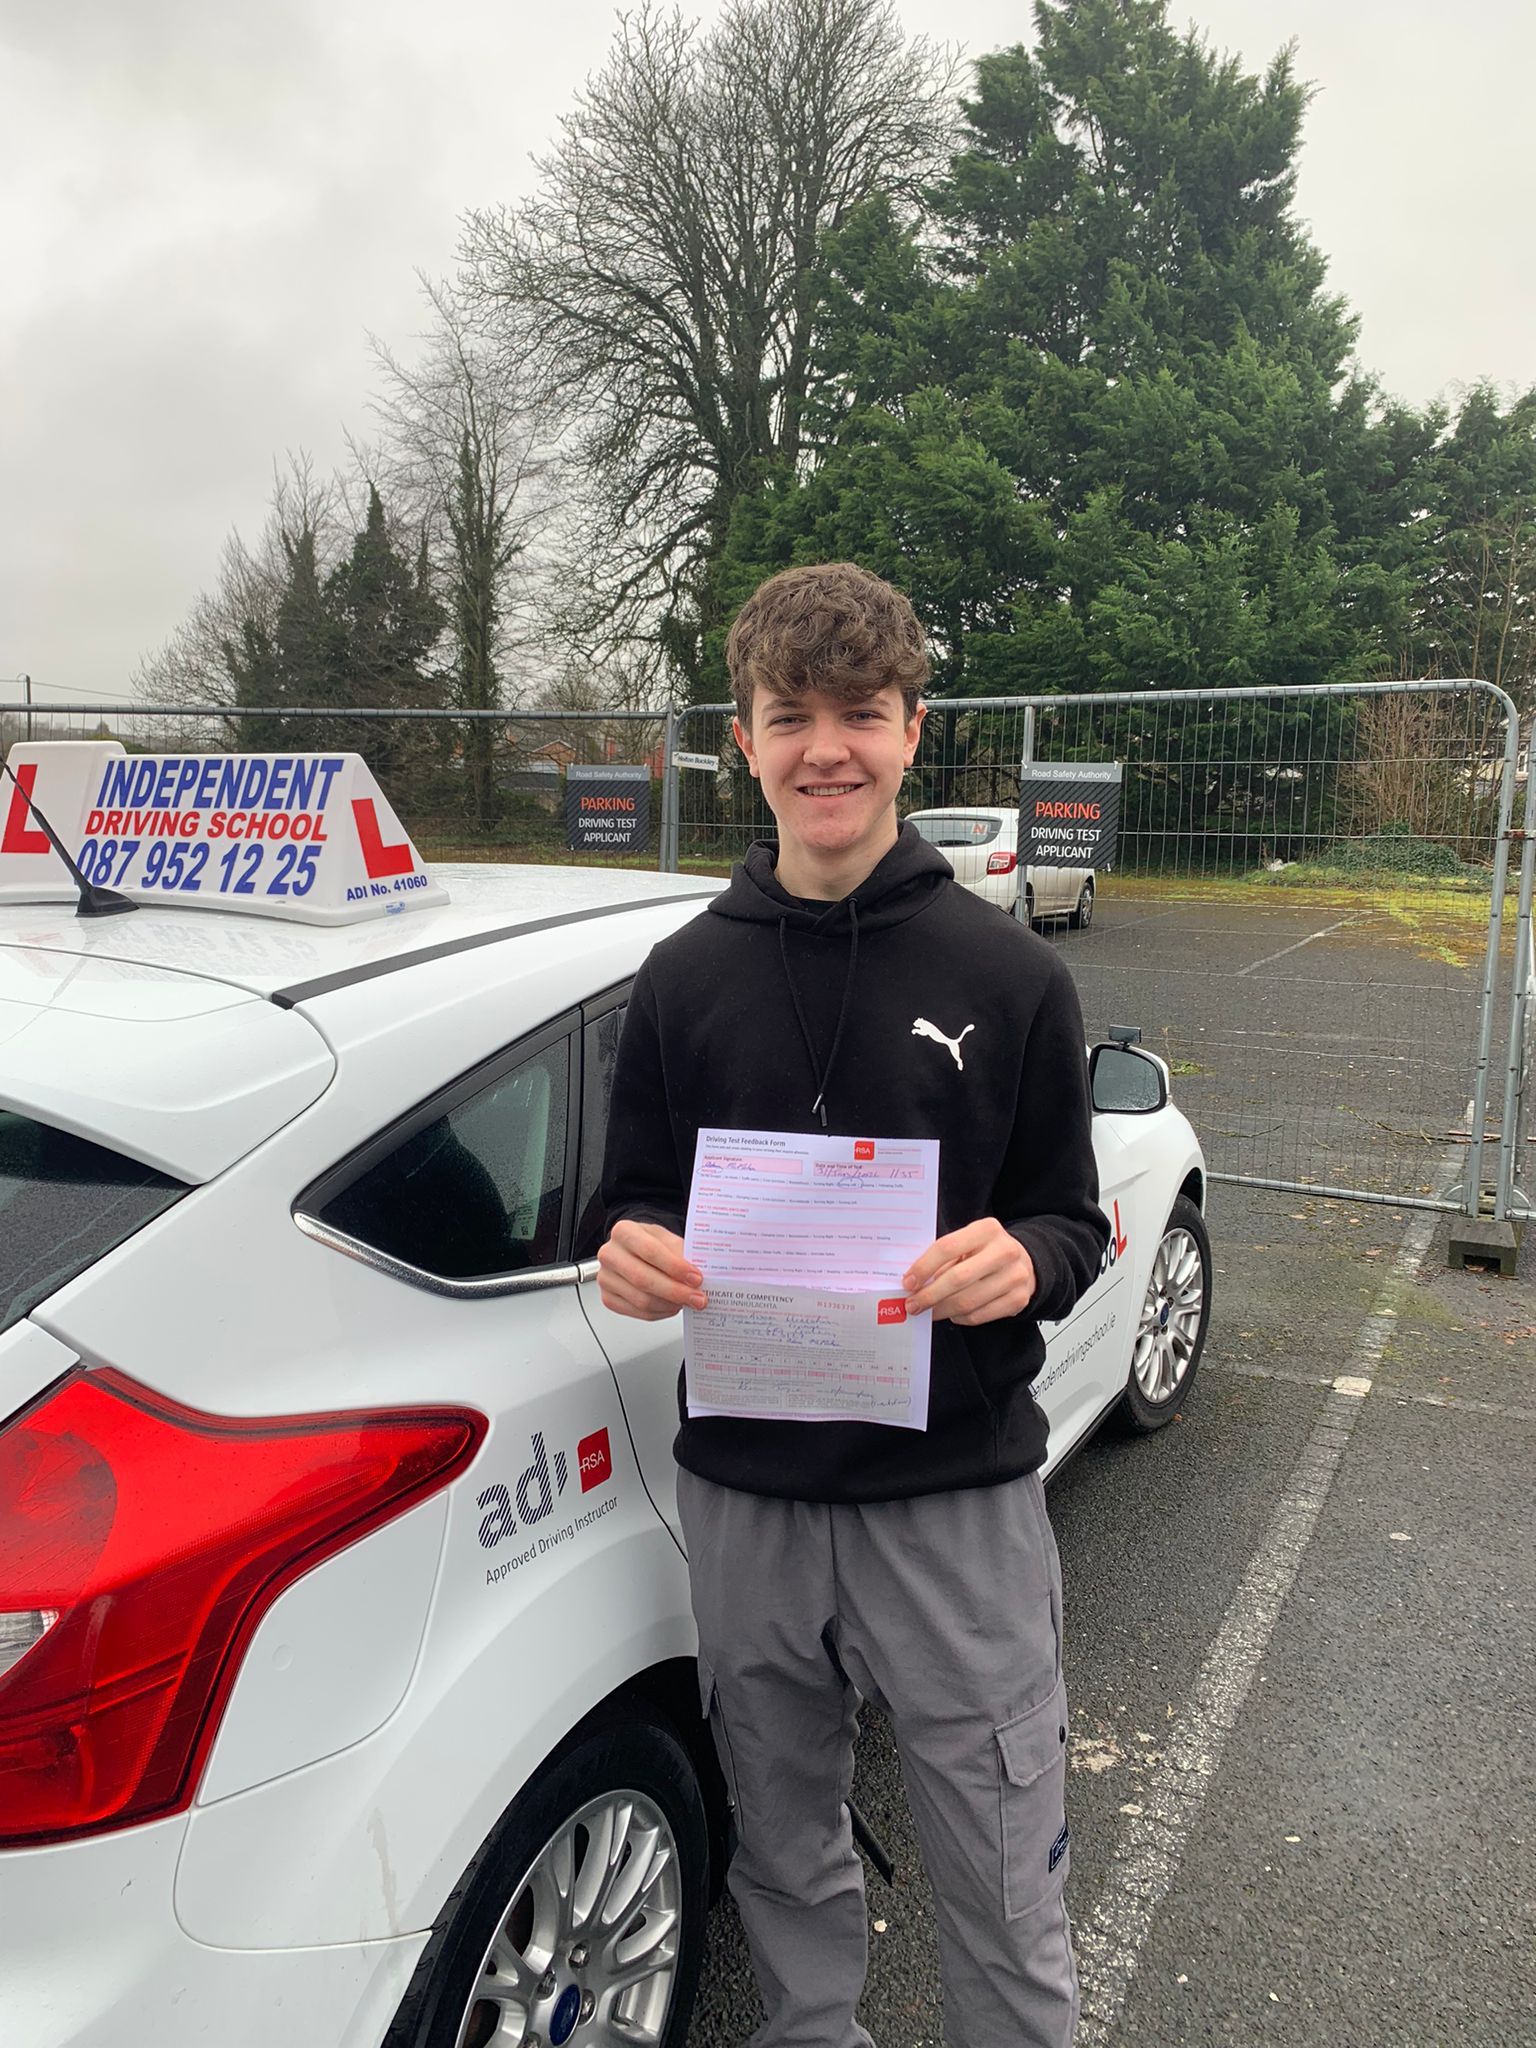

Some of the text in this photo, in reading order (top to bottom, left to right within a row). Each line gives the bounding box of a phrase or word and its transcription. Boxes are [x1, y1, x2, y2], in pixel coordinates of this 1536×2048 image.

[575, 770, 642, 780] Road Safety Authority
[1031, 769, 1112, 781] Road Safety Authority
[96, 759, 345, 811] INDEPENDENT
[580, 796, 636, 812] PARKING
[1035, 801, 1101, 821] PARKING
[85, 810, 329, 842] DRIVING SCHOOL
[578, 818, 638, 830] DRIVING TEST
[351, 797, 415, 879] L
[583, 832, 632, 843] APPLICANT
[1031, 826, 1102, 842] DRIVING TEST
[1035, 845, 1094, 859] APPLICANT
[76, 839, 323, 897] 087 952 12 25
[346, 875, 428, 901] ADI No. 41060
[705, 1135, 786, 1147] Driving Test Feedback Form
[856, 1146, 871, 1155] RSA
[735, 1290, 744, 1299] OF
[746, 1291, 794, 1304] COMPETENCY
[880, 1306, 902, 1317] RSA
[580, 1449, 606, 1474] RSA
[486, 1496, 618, 1585] Approved Driving Instructor
